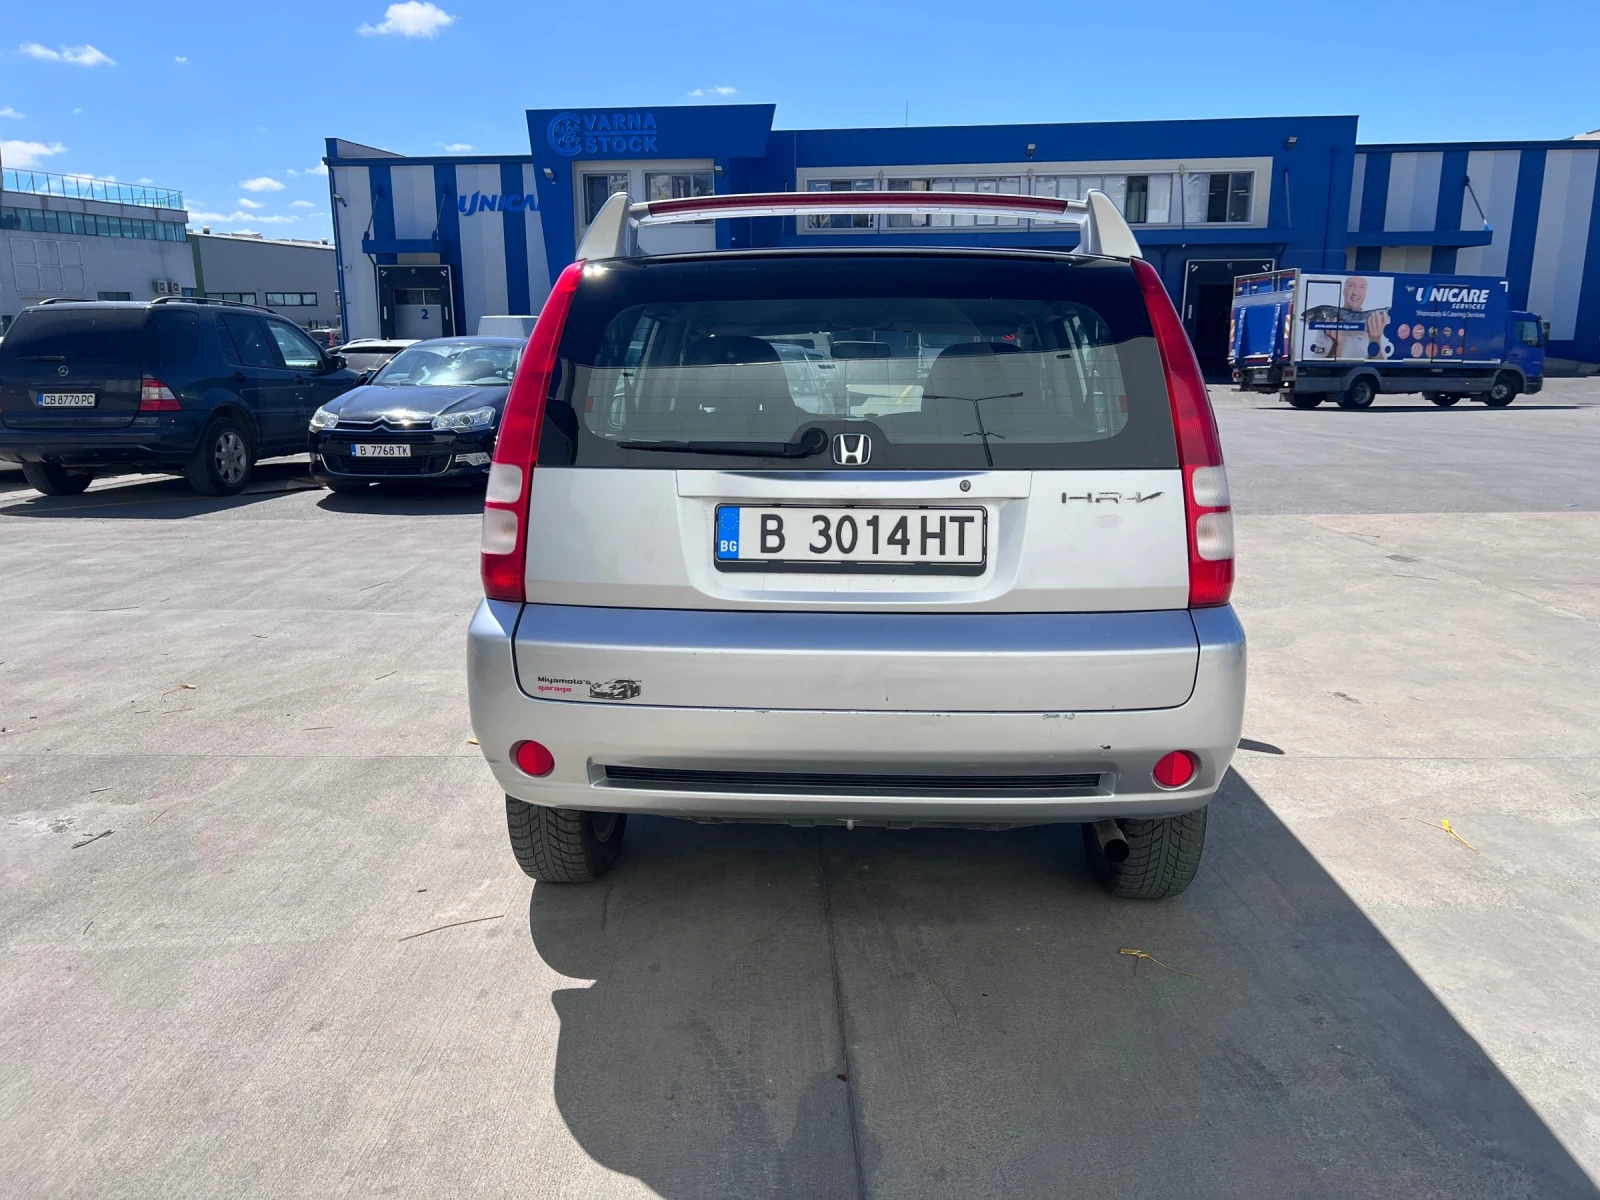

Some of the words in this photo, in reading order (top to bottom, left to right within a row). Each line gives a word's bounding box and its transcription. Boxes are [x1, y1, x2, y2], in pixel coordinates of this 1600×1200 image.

[582, 112, 656, 130] VARNA
[584, 135, 657, 154] STOCK
[458, 190, 539, 216] UNICA
[1416, 285, 1489, 304] UNICARE
[421, 309, 429, 320] 2
[44, 395, 56, 405] CB
[57, 395, 80, 405] 8770
[81, 395, 93, 405] PC
[360, 445, 367, 456] B
[370, 445, 395, 456] 7768
[396, 445, 409, 456] TK
[760, 514, 786, 554] B
[720, 540, 738, 553] BG
[537, 676, 592, 685] Miyamoto's
[538, 685, 573, 693] garage
